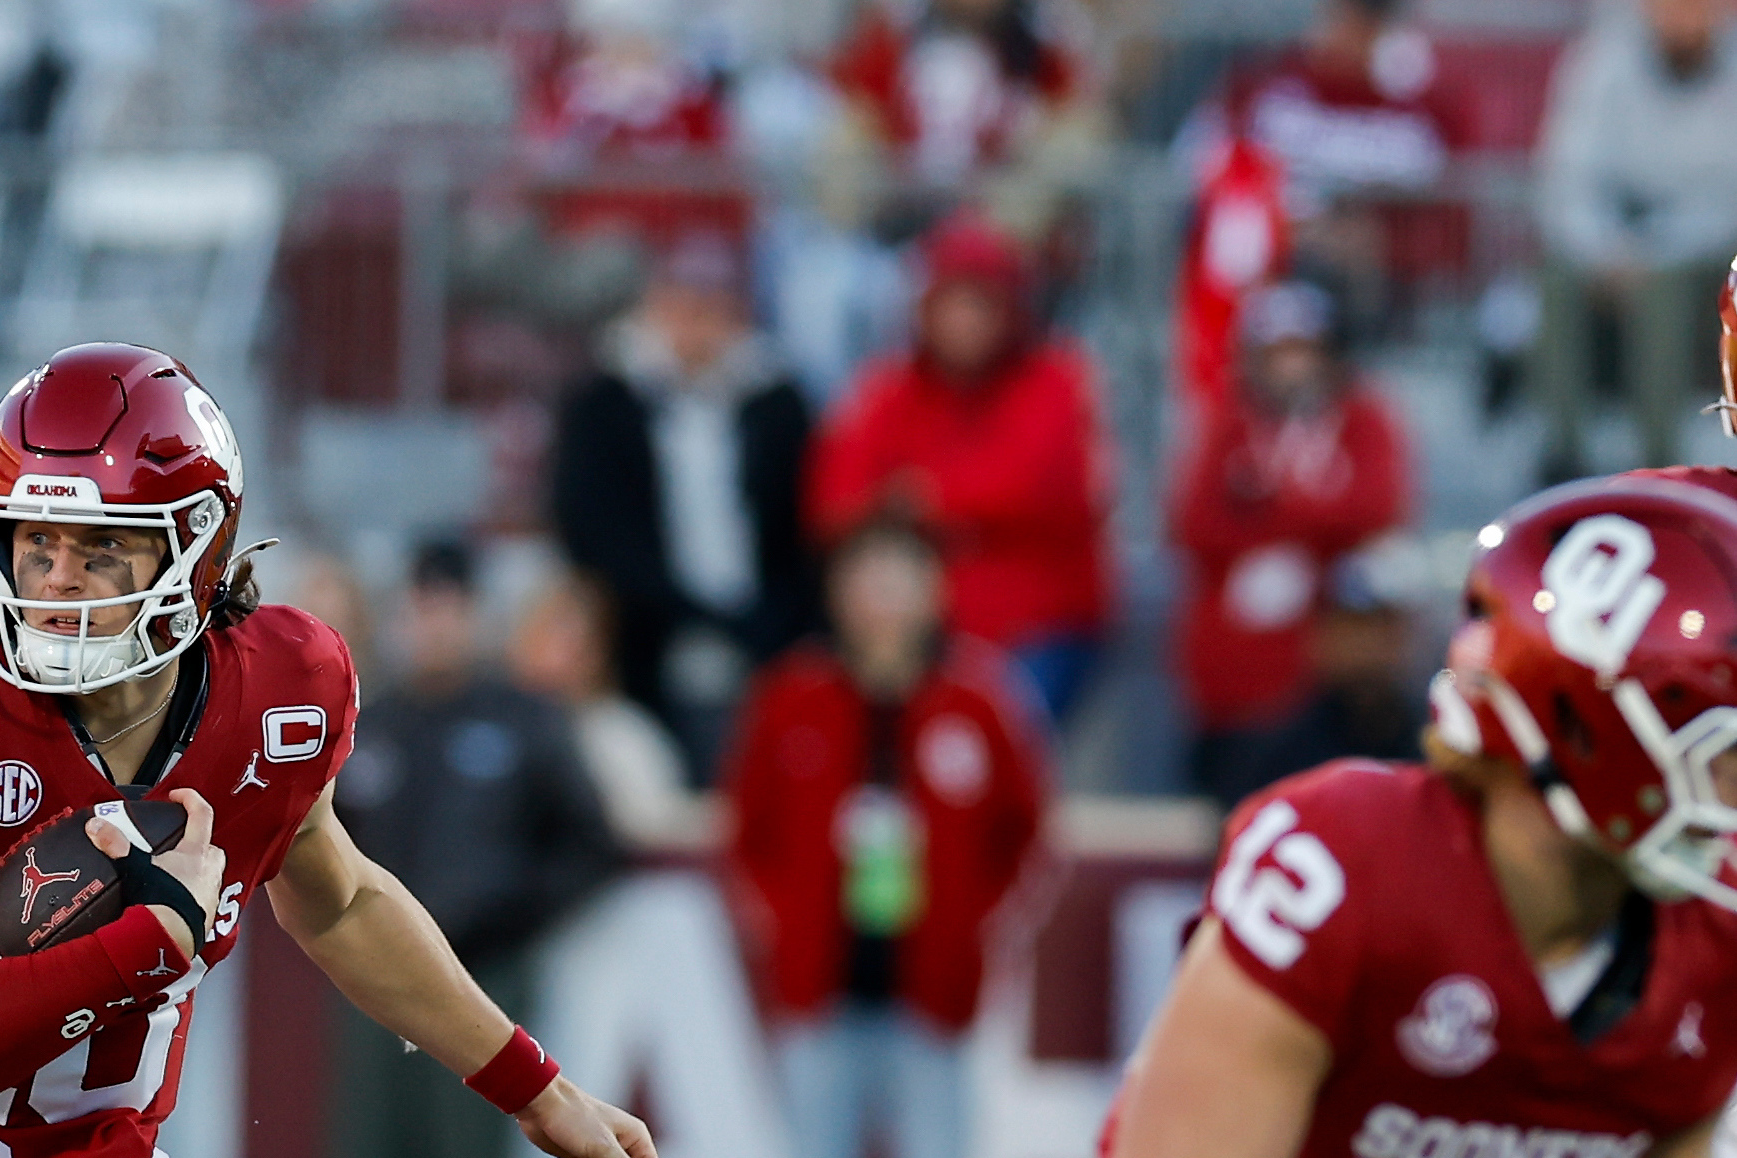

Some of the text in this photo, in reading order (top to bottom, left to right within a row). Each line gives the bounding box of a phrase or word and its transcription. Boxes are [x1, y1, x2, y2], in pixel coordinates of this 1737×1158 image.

[27, 484, 78, 497] OKLAHOMA
[265, 709, 323, 759] C
[1212, 798, 1346, 970] 12
